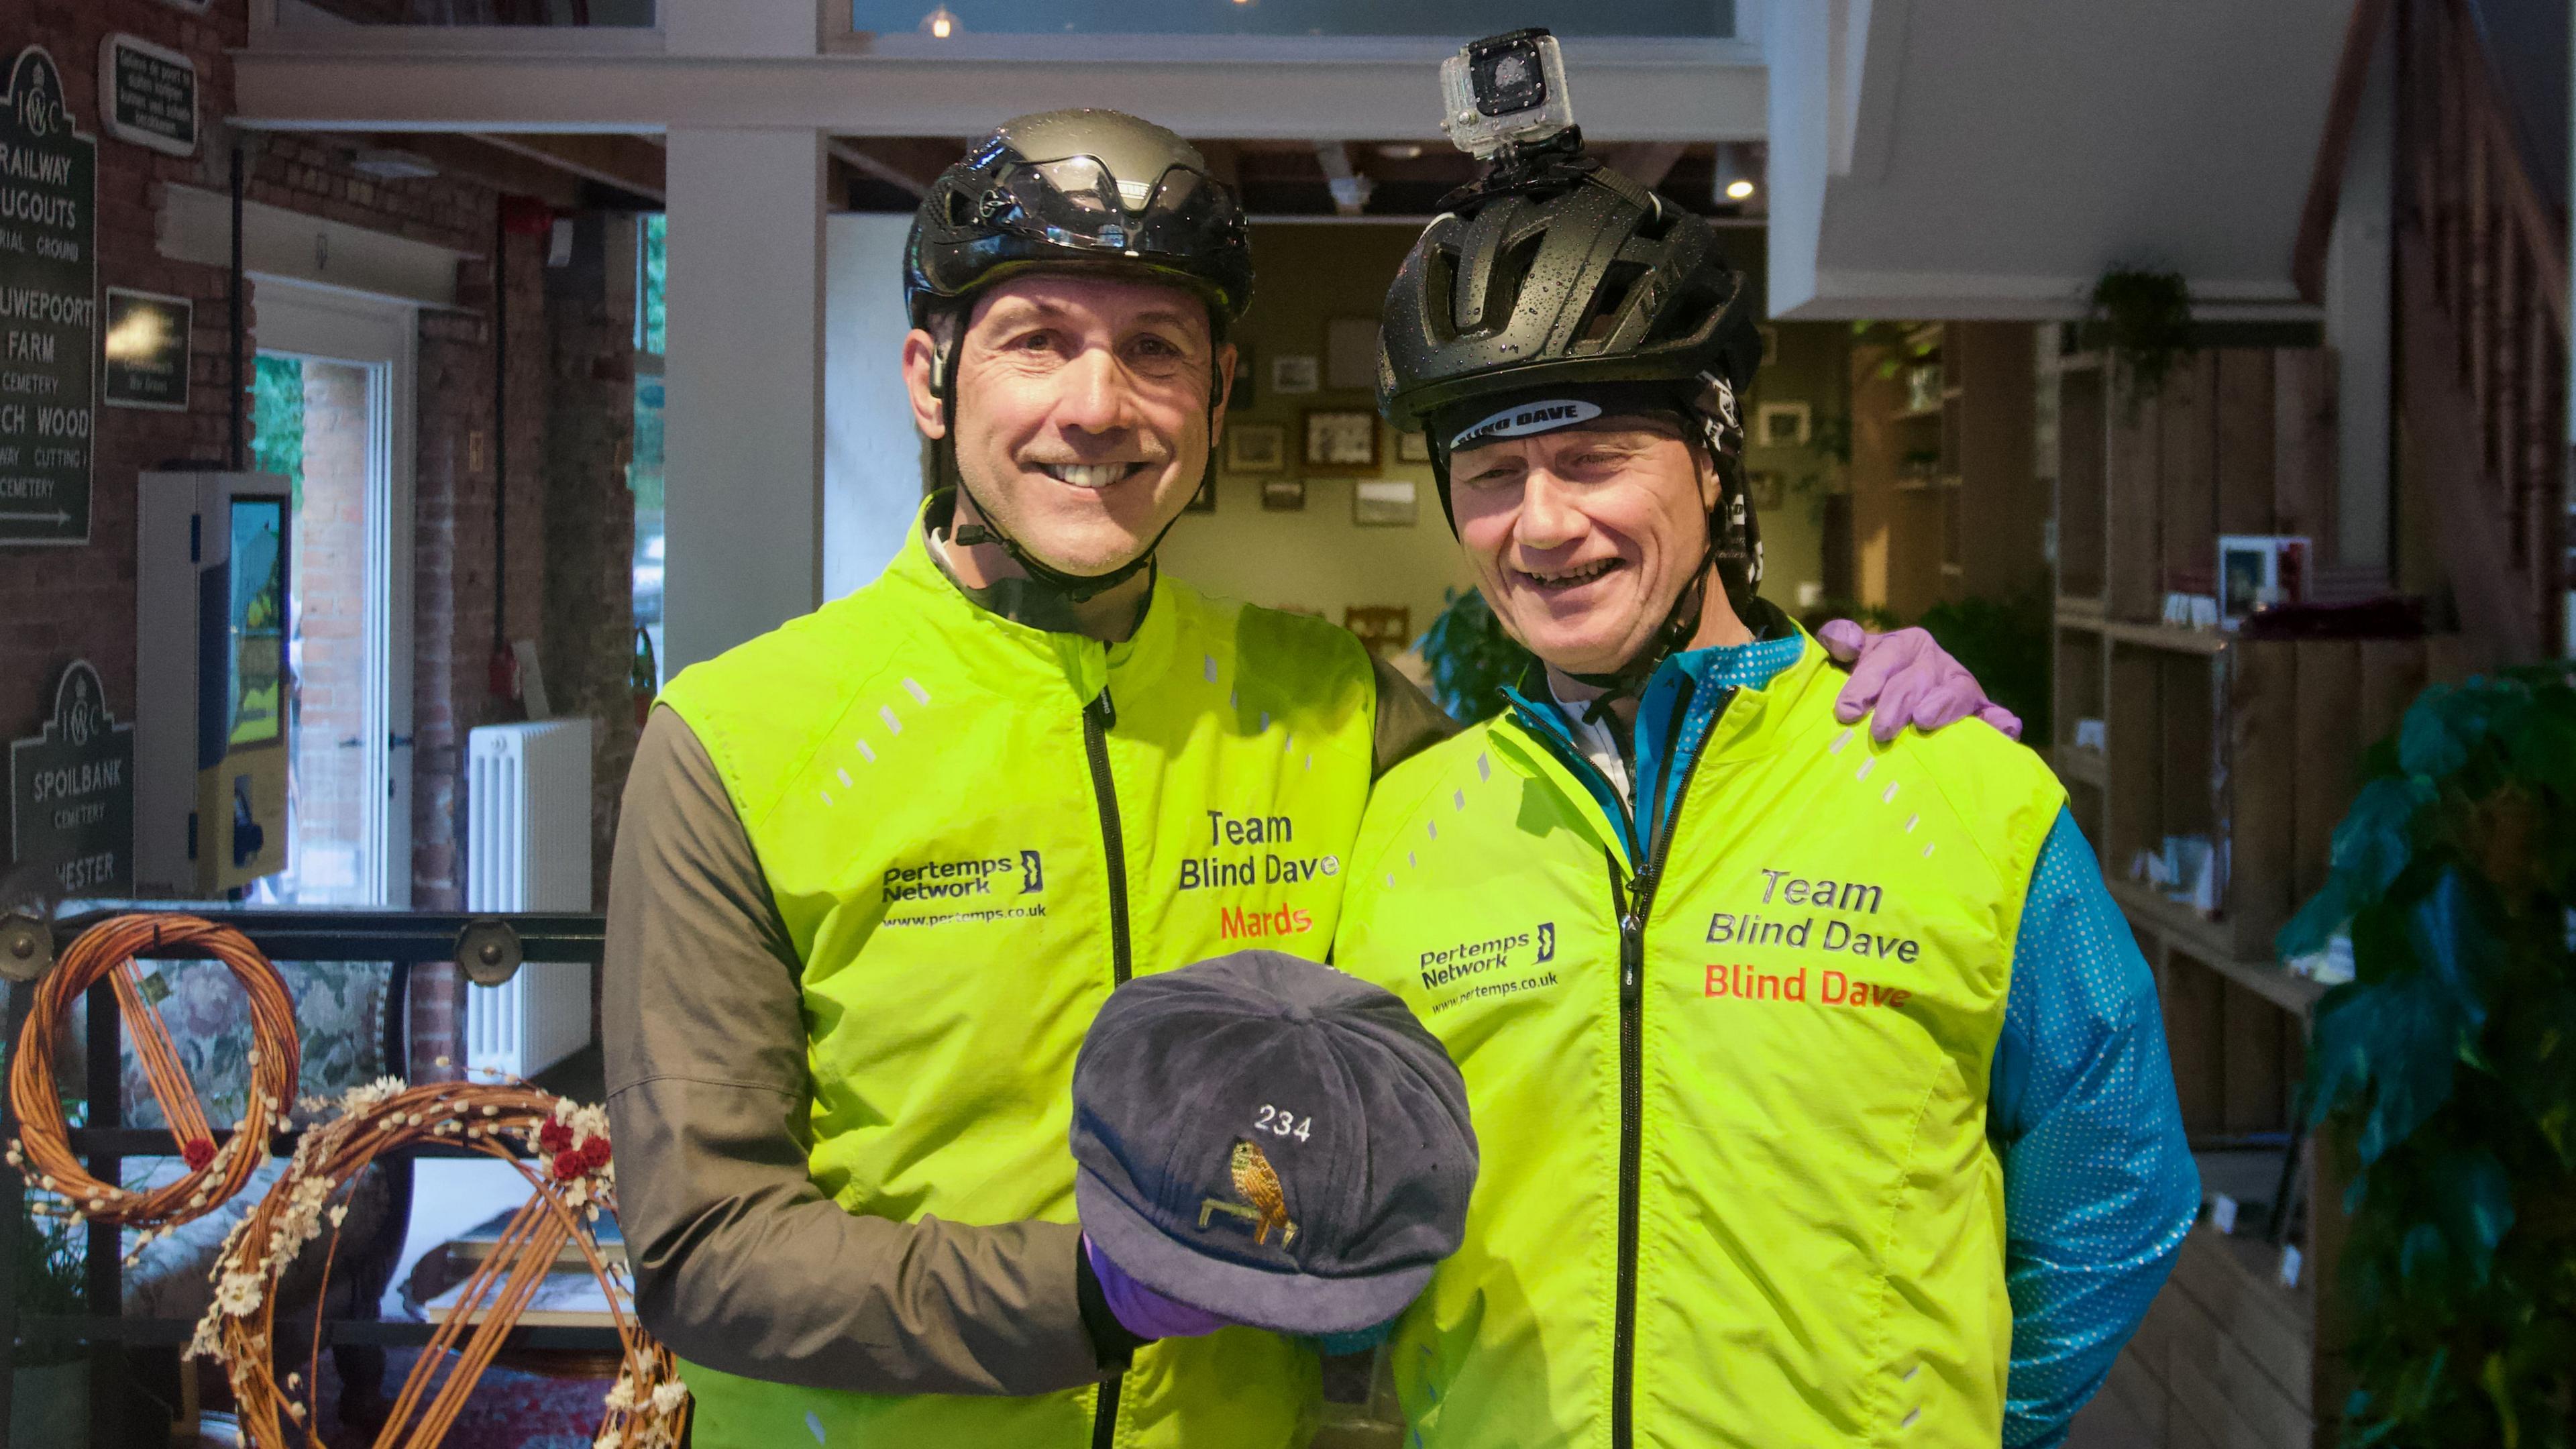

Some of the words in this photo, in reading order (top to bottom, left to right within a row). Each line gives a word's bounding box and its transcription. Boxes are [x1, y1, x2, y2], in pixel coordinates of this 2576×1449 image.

[36, 235, 78, 262] GROUND
[9, 330, 55, 364] FARM
[2, 370, 59, 395] CEMETERY
[37, 405, 89, 438] WOOD
[1517, 405, 1578, 427] DAVE
[0, 476, 55, 499] CEMETERY
[33, 759, 122, 803] SPOILBANK
[54, 803, 105, 829] CEMETERY
[1207, 810, 1292, 847] Team
[882, 878, 990, 902] Network
[883, 858, 1012, 886] Pertemps
[1179, 855, 1255, 891] Blind
[1265, 854, 1341, 885] Dave
[1762, 869, 1884, 914] Team
[883, 904, 1046, 928] www.pertemps.co.uk
[1221, 902, 1313, 940] Mards
[1420, 933, 1529, 970] Pertemps
[1706, 913, 1814, 949] Blind
[1823, 920, 1920, 964] Dave
[1421, 953, 1507, 990] Network
[1705, 964, 1807, 1002] Blind
[1821, 970, 1912, 1008] Dave
[1432, 972, 1558, 1015] www.pertemps.co.uk
[1254, 1104, 1312, 1142] 234
